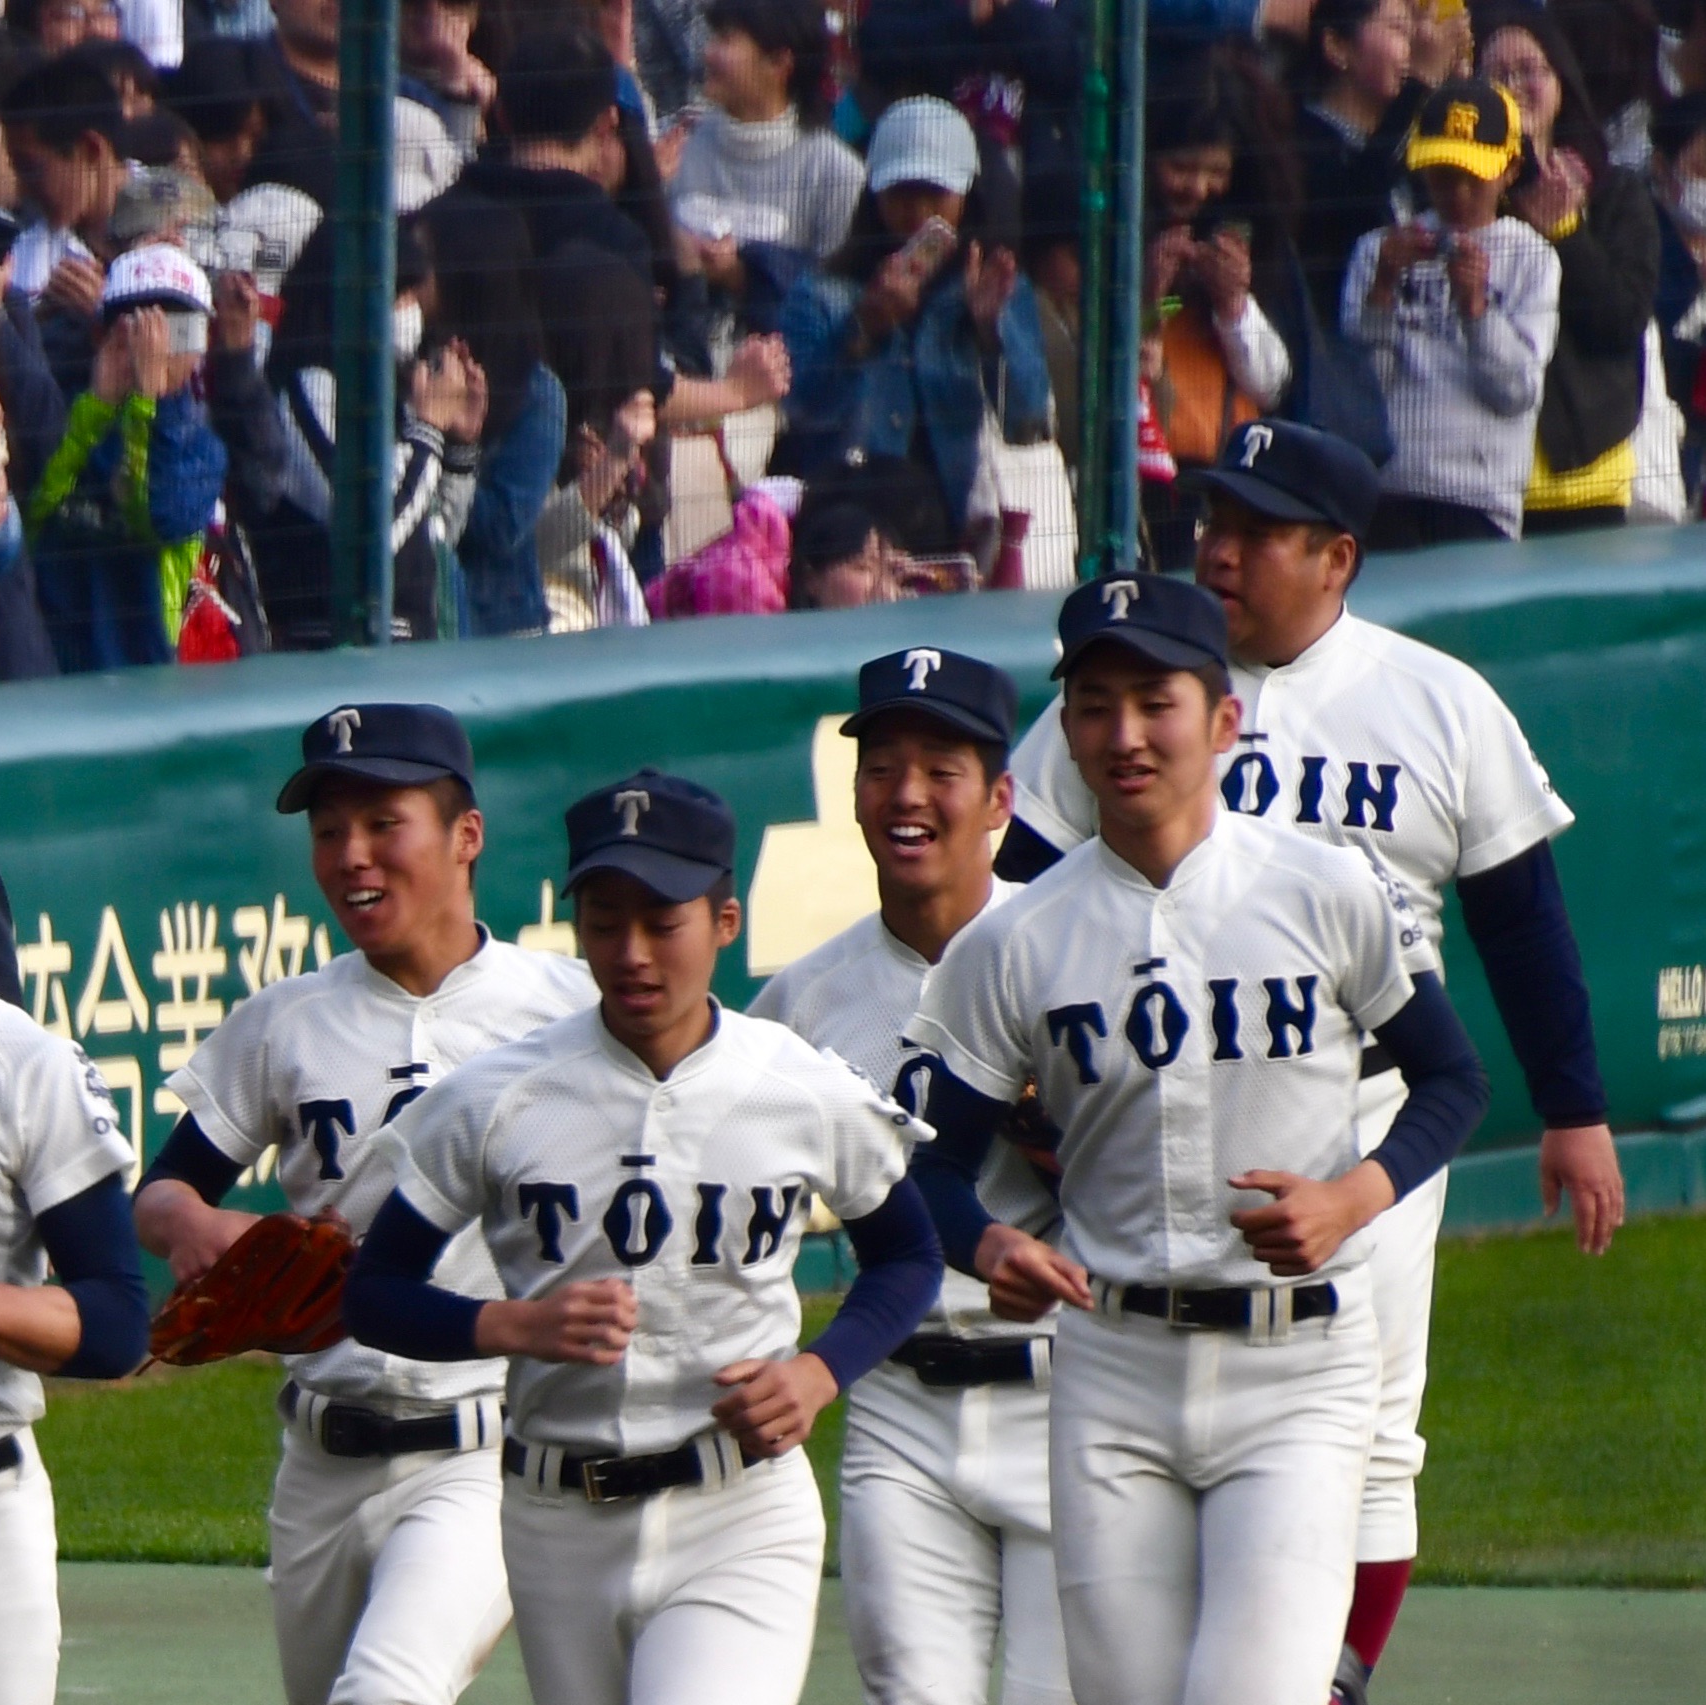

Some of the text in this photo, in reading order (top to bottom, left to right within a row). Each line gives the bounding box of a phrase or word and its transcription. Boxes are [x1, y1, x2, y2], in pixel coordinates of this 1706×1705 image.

[1240, 424, 1274, 468] T
[1103, 579, 1139, 620] T
[903, 648, 942, 691] T
[328, 708, 362, 753] T
[614, 789, 651, 836] T
